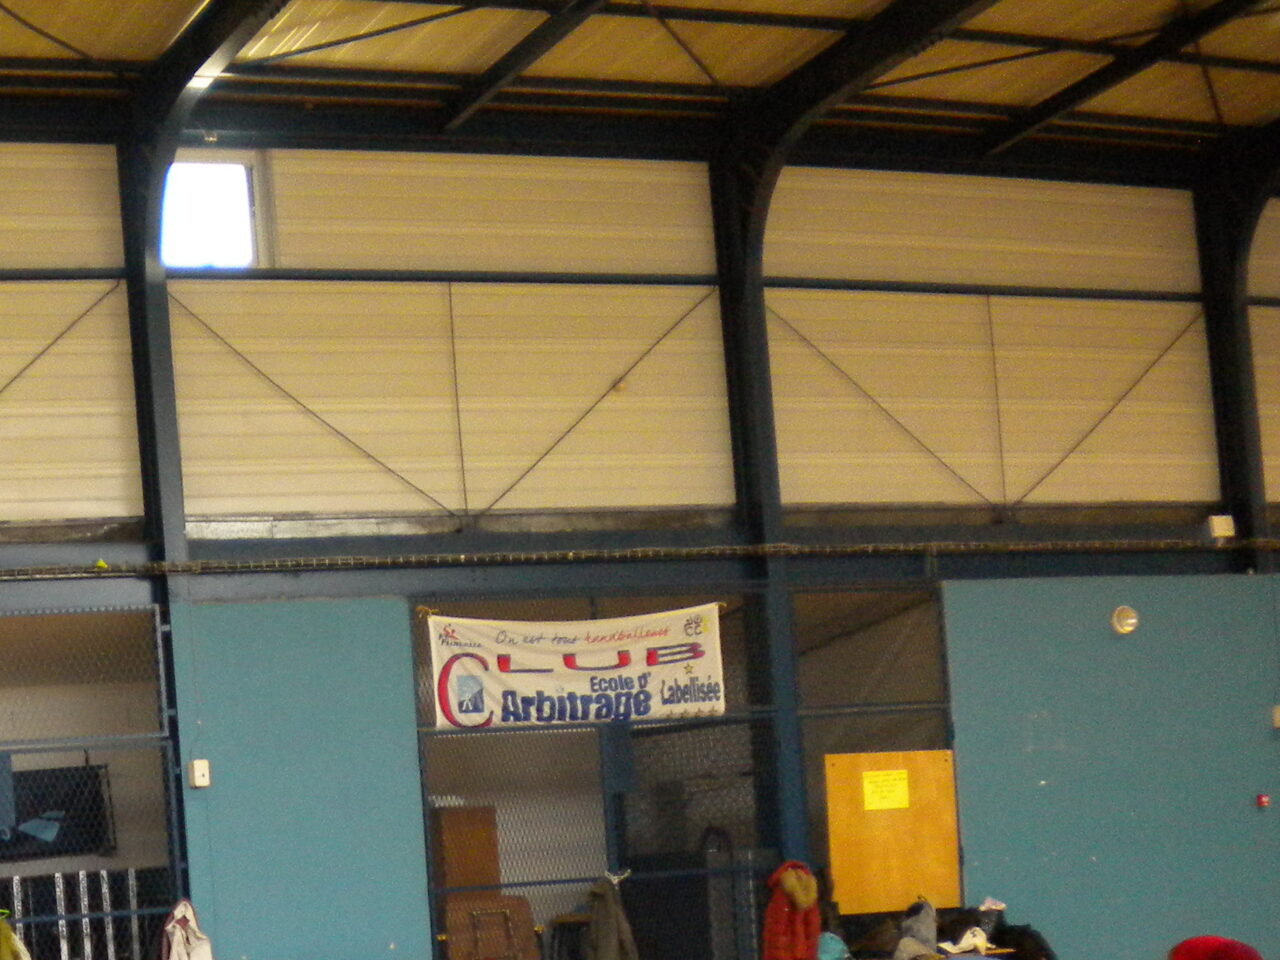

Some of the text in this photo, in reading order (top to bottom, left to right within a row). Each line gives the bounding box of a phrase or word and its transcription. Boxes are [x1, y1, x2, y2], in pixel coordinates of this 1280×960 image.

[495, 629, 519, 646] On
[522, 633, 547, 645] est
[437, 642, 706, 729] CLUB
[590, 675, 635, 693] Ecole
[500, 689, 653, 722] Arbitrage
